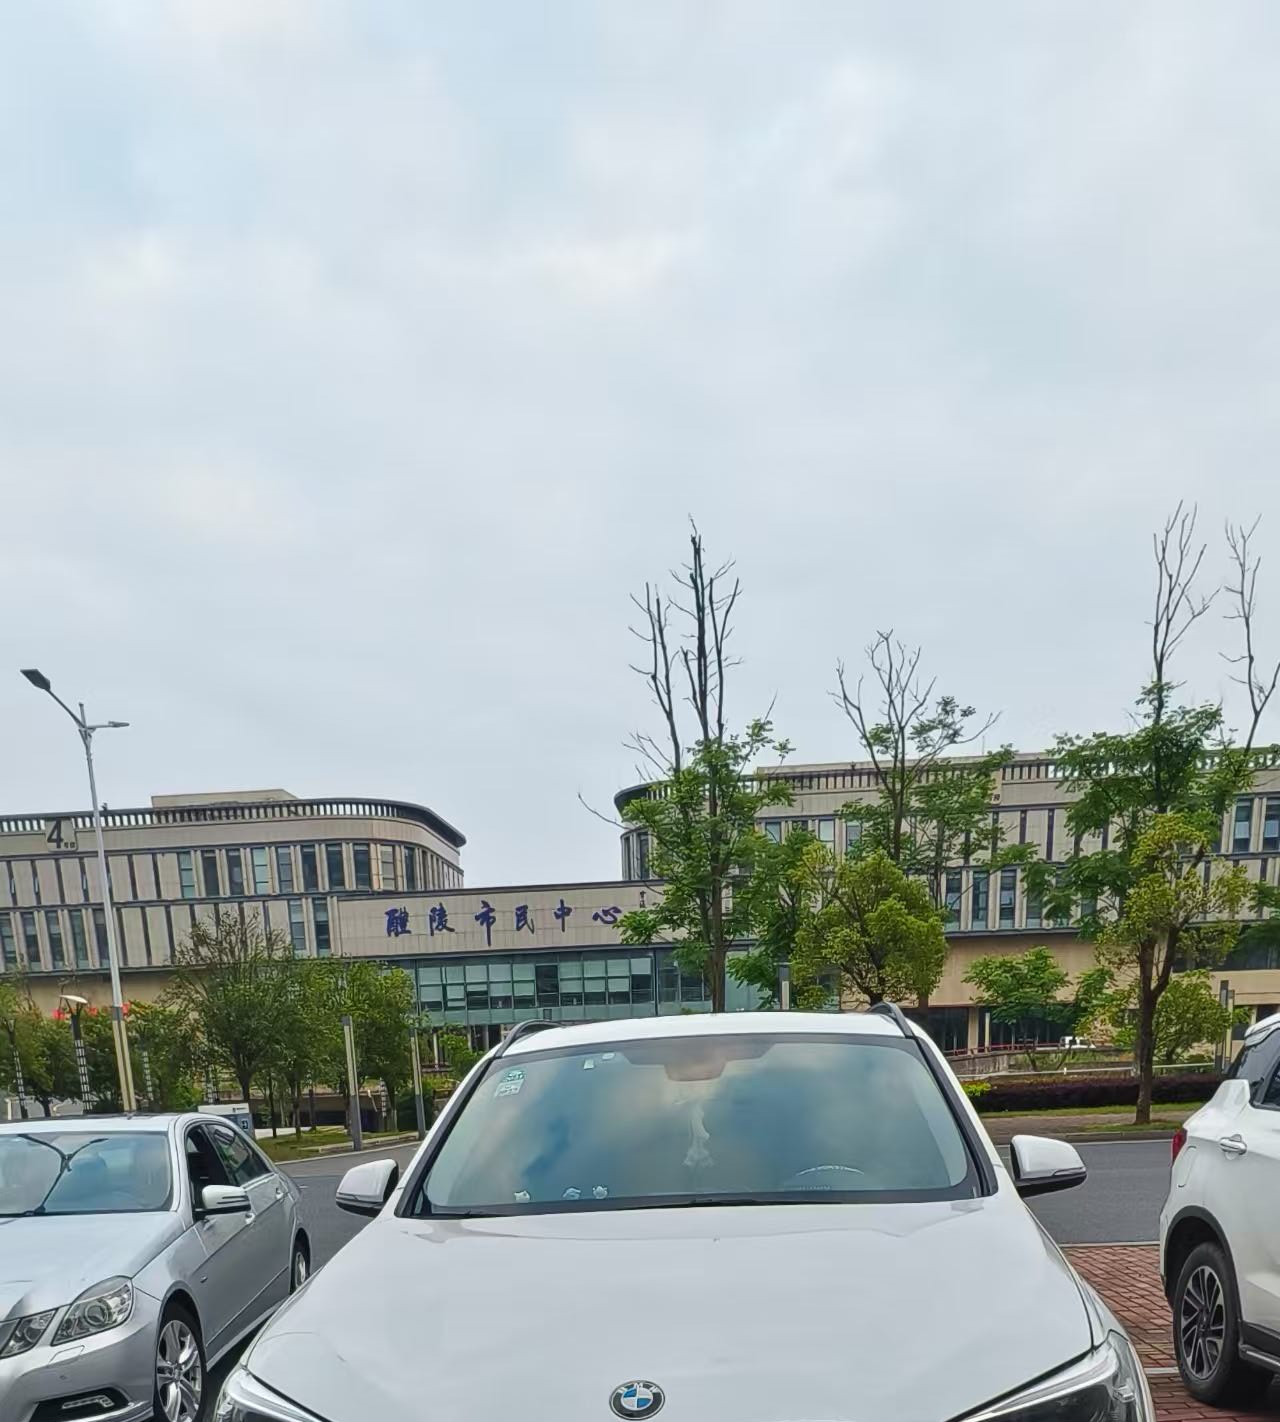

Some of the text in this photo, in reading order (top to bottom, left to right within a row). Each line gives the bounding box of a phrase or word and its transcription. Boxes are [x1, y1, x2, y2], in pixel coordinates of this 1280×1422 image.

[385, 899, 622, 947] 醴陵市民中心
